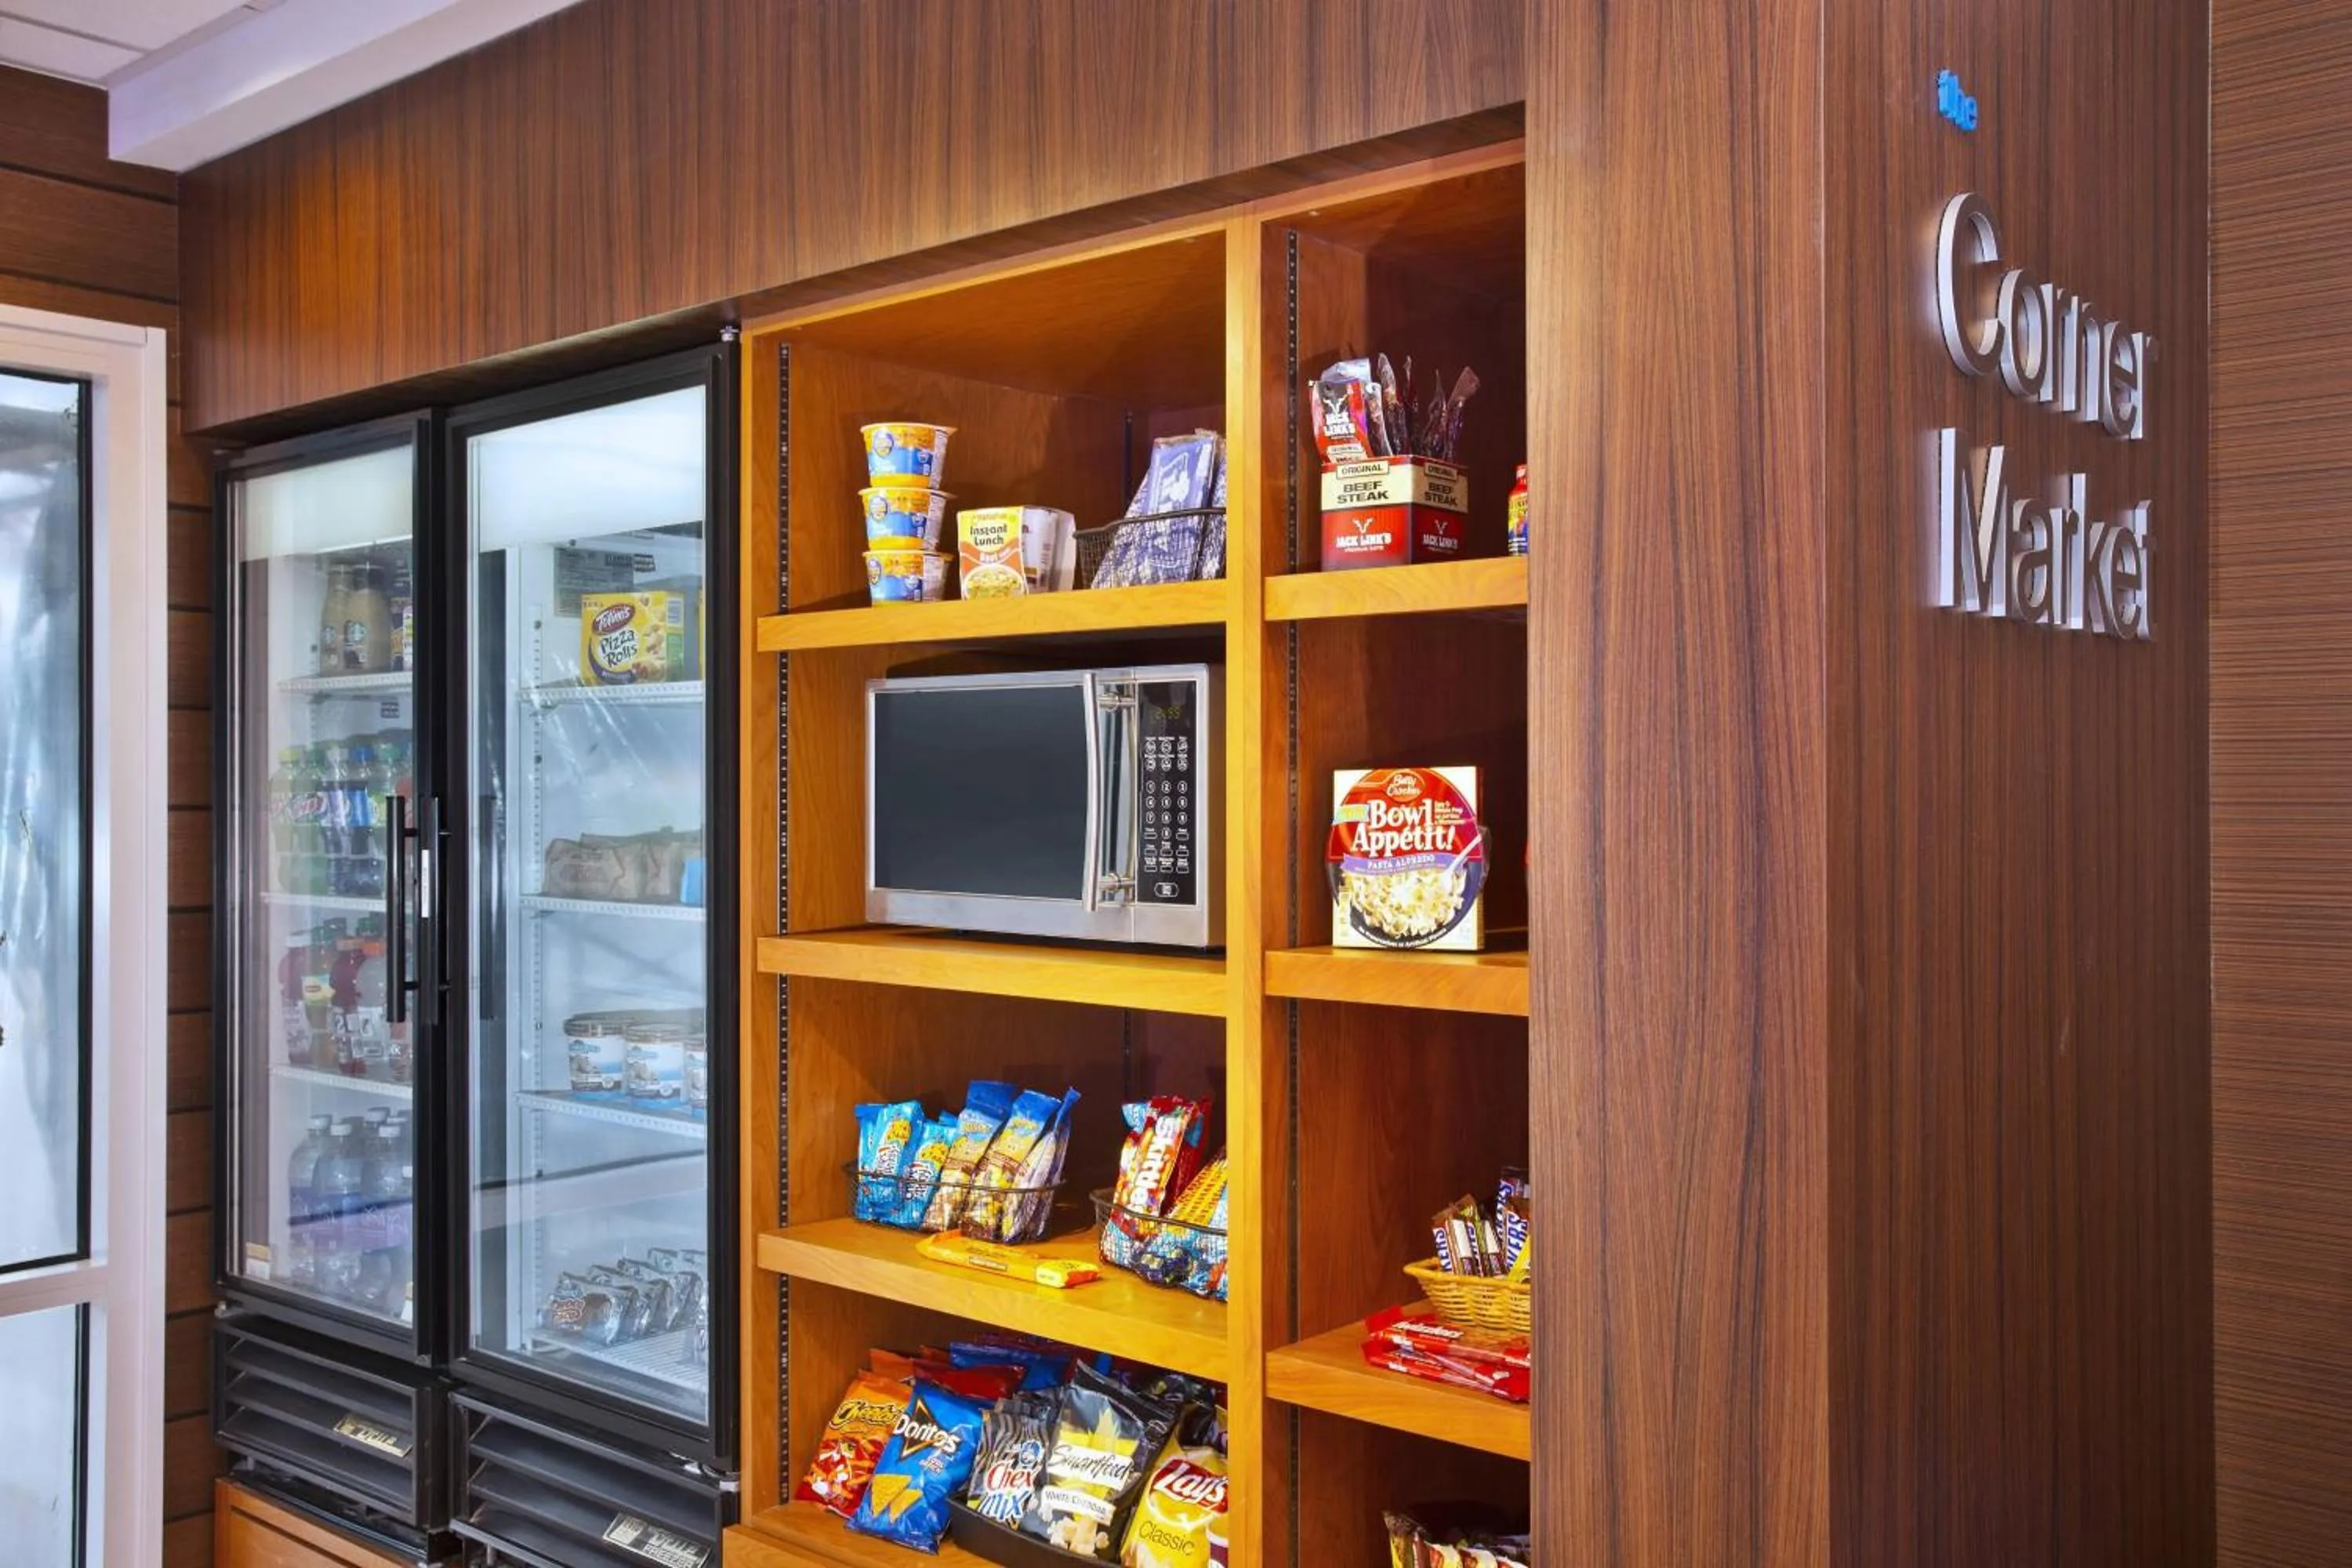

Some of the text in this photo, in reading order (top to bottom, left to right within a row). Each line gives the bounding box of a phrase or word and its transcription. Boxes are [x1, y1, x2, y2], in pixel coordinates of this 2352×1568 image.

[1936, 192, 2158, 440] Corner
[1341, 463, 1384, 475] ORIGINAL
[1337, 490, 1389, 504] STEAK
[1344, 481, 1382, 493] BEEF
[1428, 482, 1454, 495] BEEF
[1425, 492, 1459, 506] STEAK
[970, 524, 1007, 535] Instant
[974, 535, 1004, 547] Lunch
[1336, 535, 1359, 547] JACK
[1940, 427, 2156, 641] Market
[601, 630, 634, 654] Pizza
[604, 644, 637, 667] Rolls
[1367, 798, 1433, 829] Bowl
[892, 1413, 961, 1455] Doritos
[1047, 1443, 1134, 1480] Smartfood
[986, 1461, 1042, 1490] Chex
[1139, 1520, 1195, 1556] Classic
